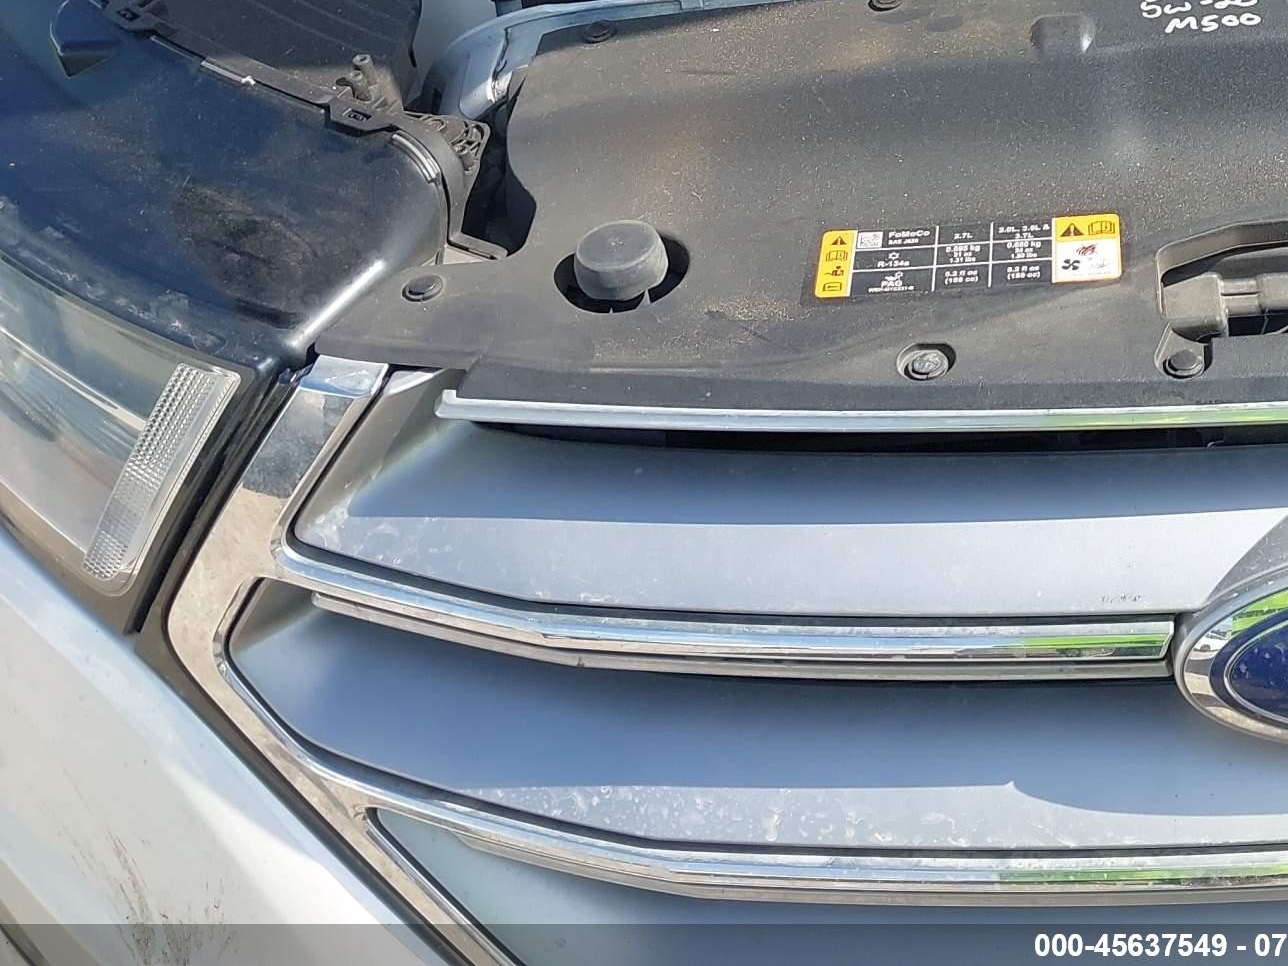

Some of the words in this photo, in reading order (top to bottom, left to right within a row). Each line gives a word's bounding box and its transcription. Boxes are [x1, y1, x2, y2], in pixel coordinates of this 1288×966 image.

[1164, 12, 1261, 34] M500
[888, 230, 931, 239] FoMoCo
[876, 260, 910, 268] R-134a
[880, 280, 903, 288] PAG
